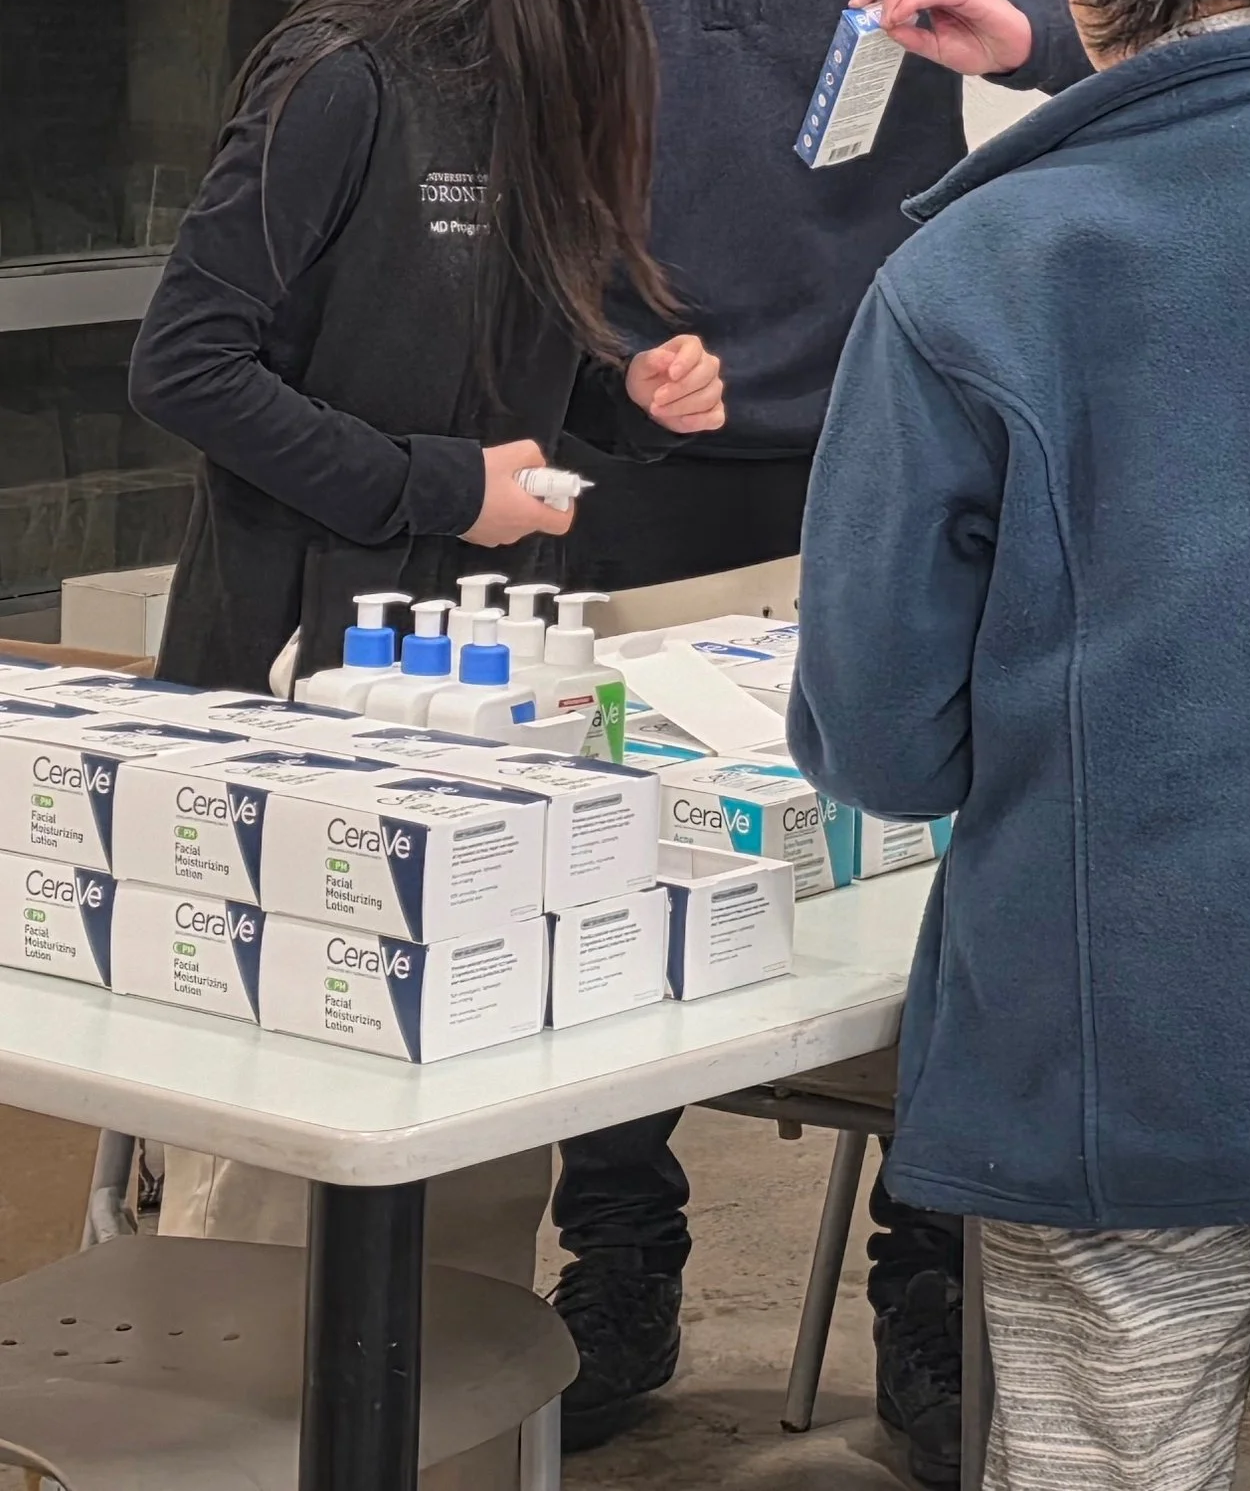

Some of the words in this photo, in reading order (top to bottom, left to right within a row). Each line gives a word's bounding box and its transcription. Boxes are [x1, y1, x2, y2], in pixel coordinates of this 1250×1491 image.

[419, 184, 488, 204] TORONT
[430, 220, 449, 234] MD
[32, 755, 111, 794] CeraVe
[175, 786, 257, 825] CeraVe
[782, 799, 838, 833] CeraVe
[31, 809, 56, 824] Facial
[673, 799, 750, 834] CeraVe
[30, 833, 58, 848] Lotion
[31, 822, 84, 844] Moisturizing
[327, 817, 412, 859] CeraVe
[175, 841, 201, 856] Facial
[175, 854, 230, 876] Moisturizing
[175, 865, 203, 881] Lotion
[25, 869, 103, 908] CeraVe
[326, 874, 353, 890] Facial
[325, 887, 383, 911] Moisturizing
[325, 898, 355, 914] Lotion
[24, 923, 49, 939] Facial
[175, 902, 255, 943] CeraVe
[24, 935, 77, 957] Moisturizing
[24, 946, 52, 961] Lotion
[173, 958, 199, 973] Facial
[326, 937, 411, 979] CeraVe
[173, 970, 228, 992] Moisturizing
[174, 981, 202, 997] Lotion
[324, 994, 352, 1010] Facial
[324, 1007, 382, 1031] Moisturizing
[324, 1019, 354, 1034] Lotion
